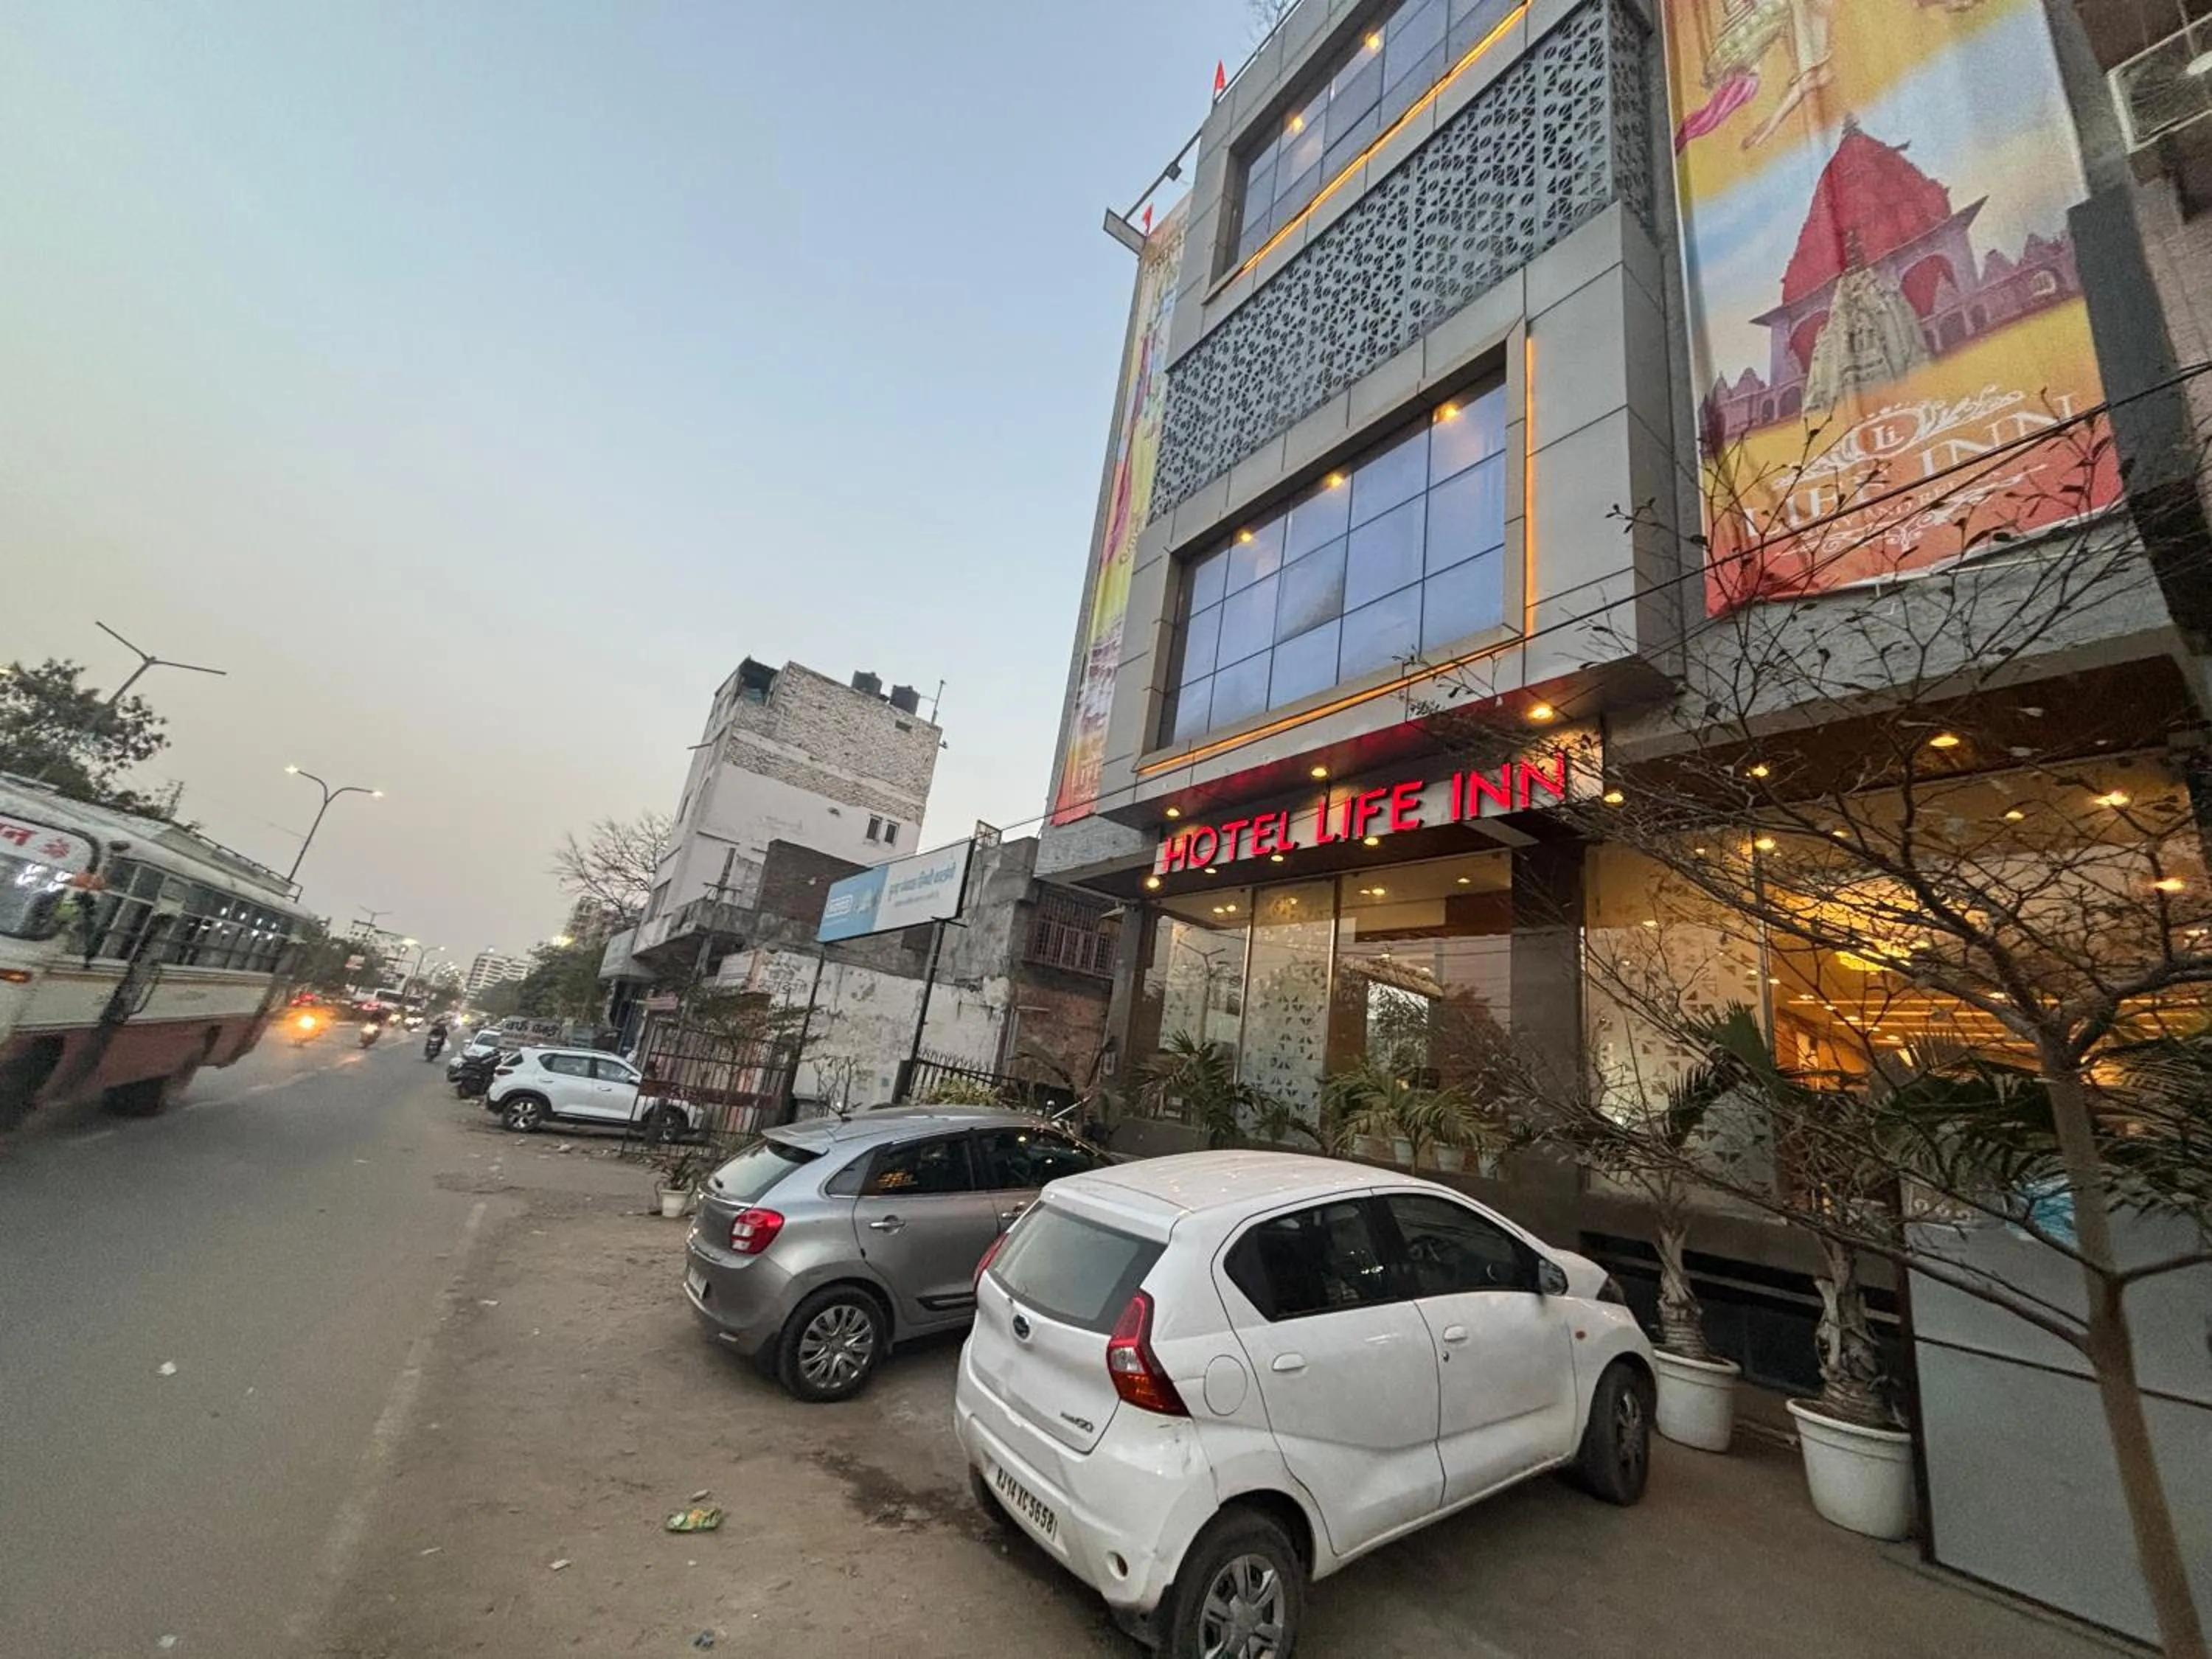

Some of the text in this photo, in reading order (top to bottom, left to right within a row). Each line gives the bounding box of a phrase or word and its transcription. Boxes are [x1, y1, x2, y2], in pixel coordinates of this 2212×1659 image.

[1163, 752, 1565, 873] HOTEL LIFE INN
